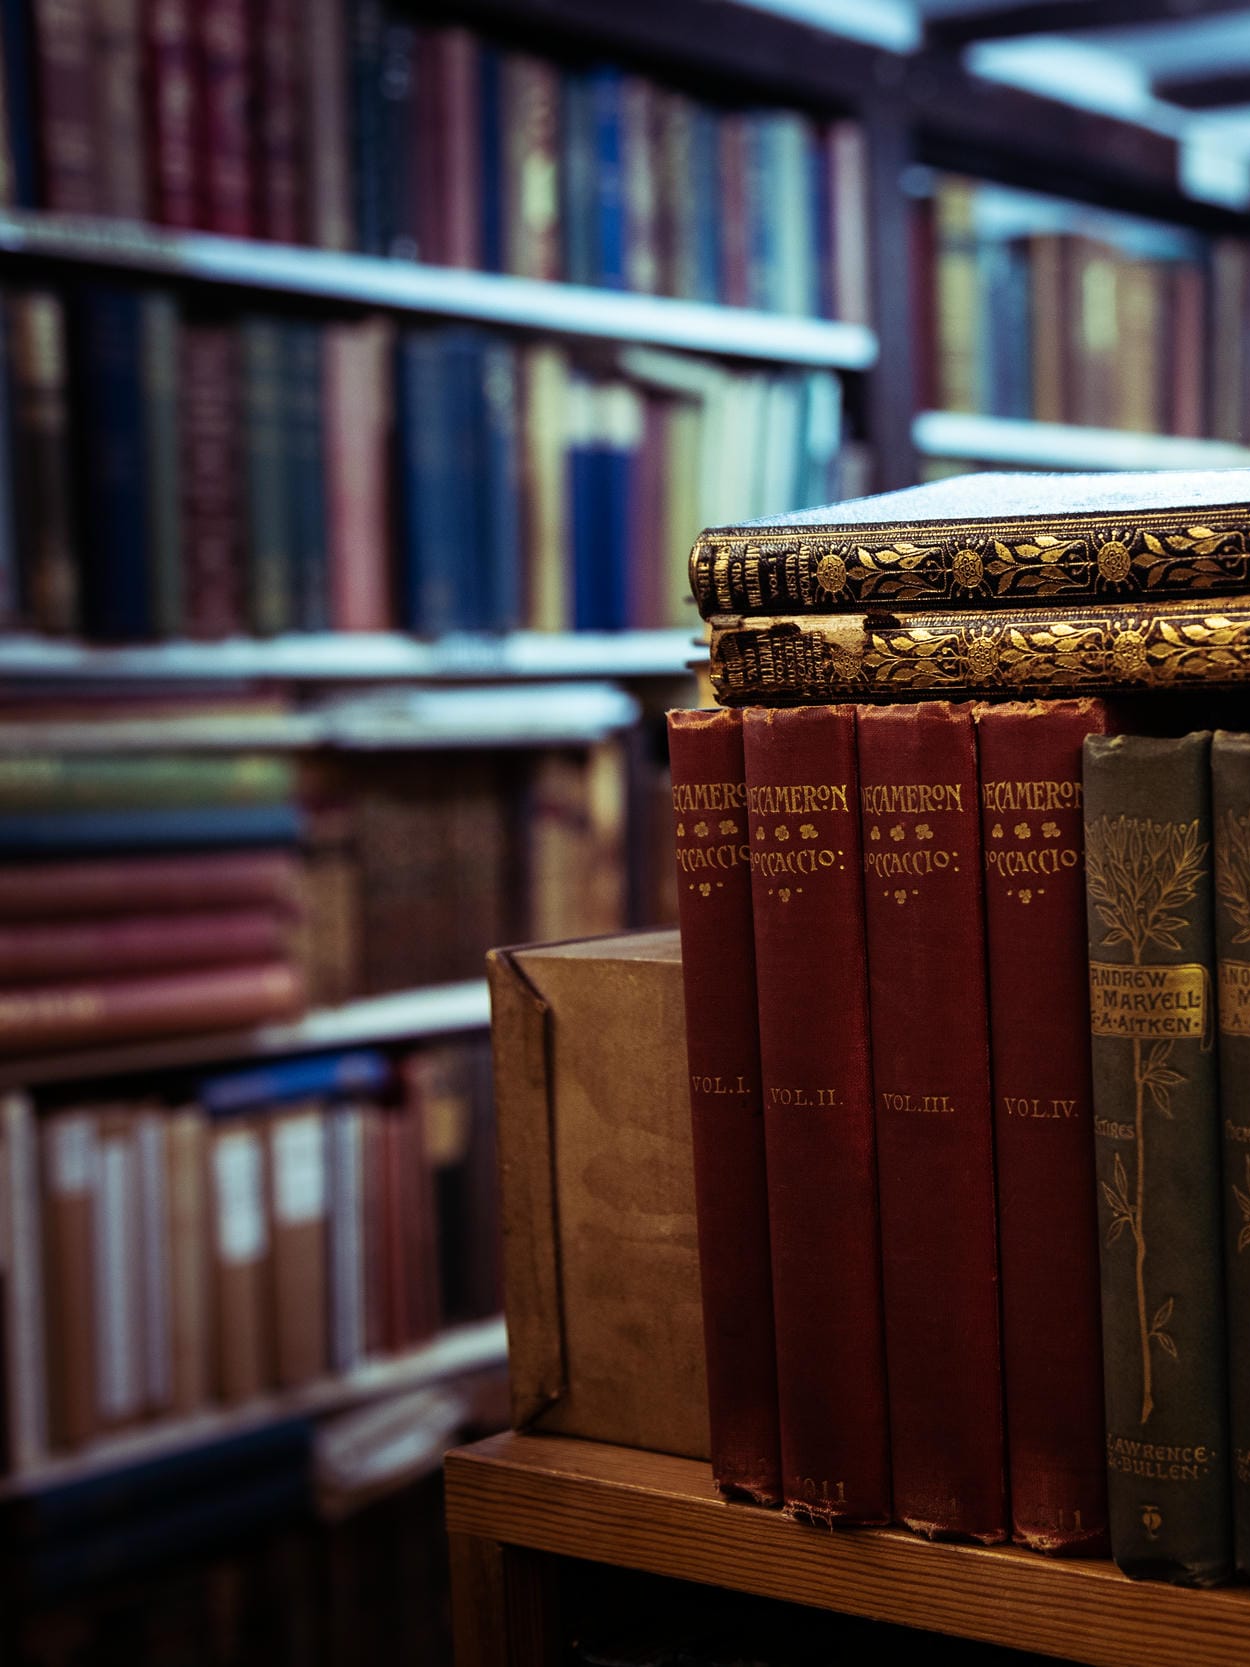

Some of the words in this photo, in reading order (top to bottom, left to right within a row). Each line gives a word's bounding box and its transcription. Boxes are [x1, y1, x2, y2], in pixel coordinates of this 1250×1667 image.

[745, 545, 761, 559] IV
[731, 561, 744, 592] AND
[744, 559, 763, 608] WILLIAM
[785, 553, 798, 600] JUSTIN
[758, 645, 775, 685] ILLIAM
[672, 783, 747, 814] ECAMERO
[749, 783, 850, 817] ECAMERON
[861, 783, 965, 816] ECAMERON
[983, 780, 1084, 815] ECAMERO
[675, 844, 750, 872] OCCACCIO
[985, 848, 1083, 877] OCCACCIO
[1091, 968, 1168, 989] ANDREW
